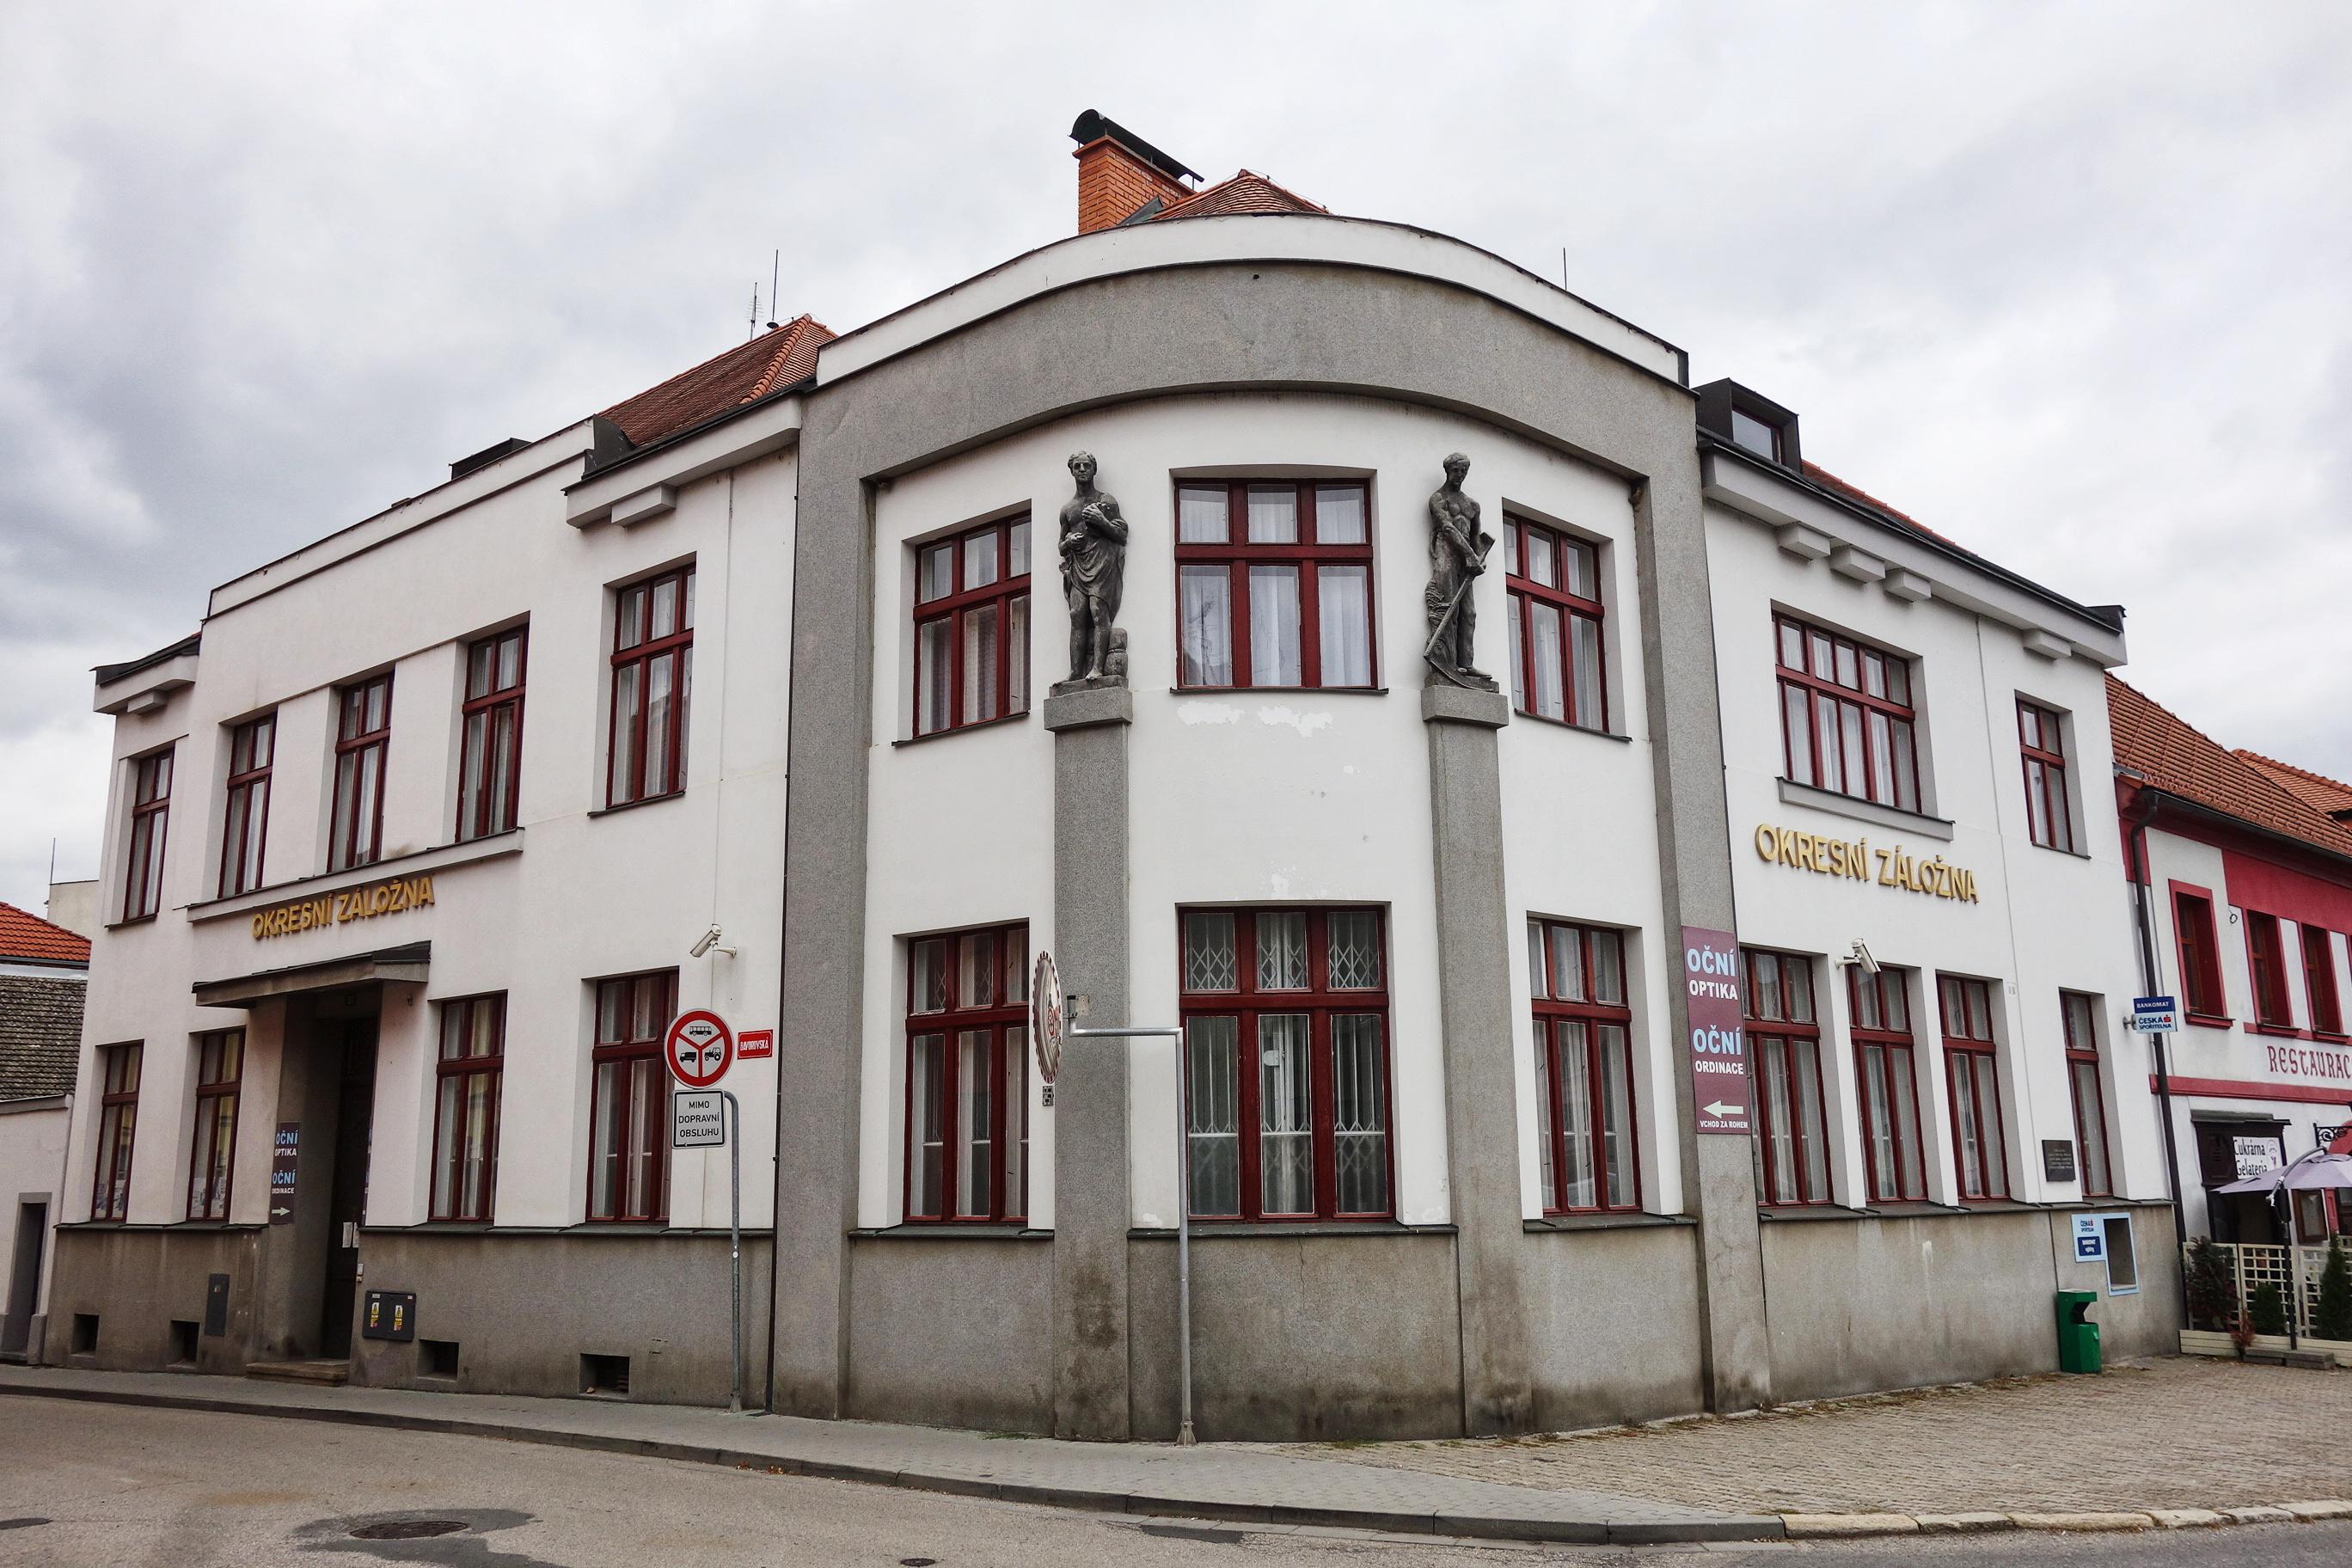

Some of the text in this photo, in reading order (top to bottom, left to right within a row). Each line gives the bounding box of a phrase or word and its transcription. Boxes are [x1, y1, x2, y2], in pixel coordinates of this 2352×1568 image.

[1755, 824, 1979, 904] OKRESNÍ ZÁLOŽNA
[251, 877, 434, 940] OKRESNÍ ZÁLOŽNA
[1687, 945, 1736, 977] OČNÍ
[1689, 979, 1738, 1001] OPTIKA
[2138, 1016, 2164, 1025] ČESKÁ
[1693, 1024, 1742, 1056] OČNÍ
[1695, 1060, 1744, 1075] ORDINACE
[689, 1100, 710, 1109] MIMO
[678, 1112, 720, 1124] DOPRAVNÍ
[276, 1130, 298, 1144] OČNÍ
[679, 1128, 719, 1137] OBSLUHU
[275, 1148, 297, 1156] OPTIKA
[2233, 1138, 2266, 1155] Cukrárna
[272, 1169, 296, 1184] OČNÍ
